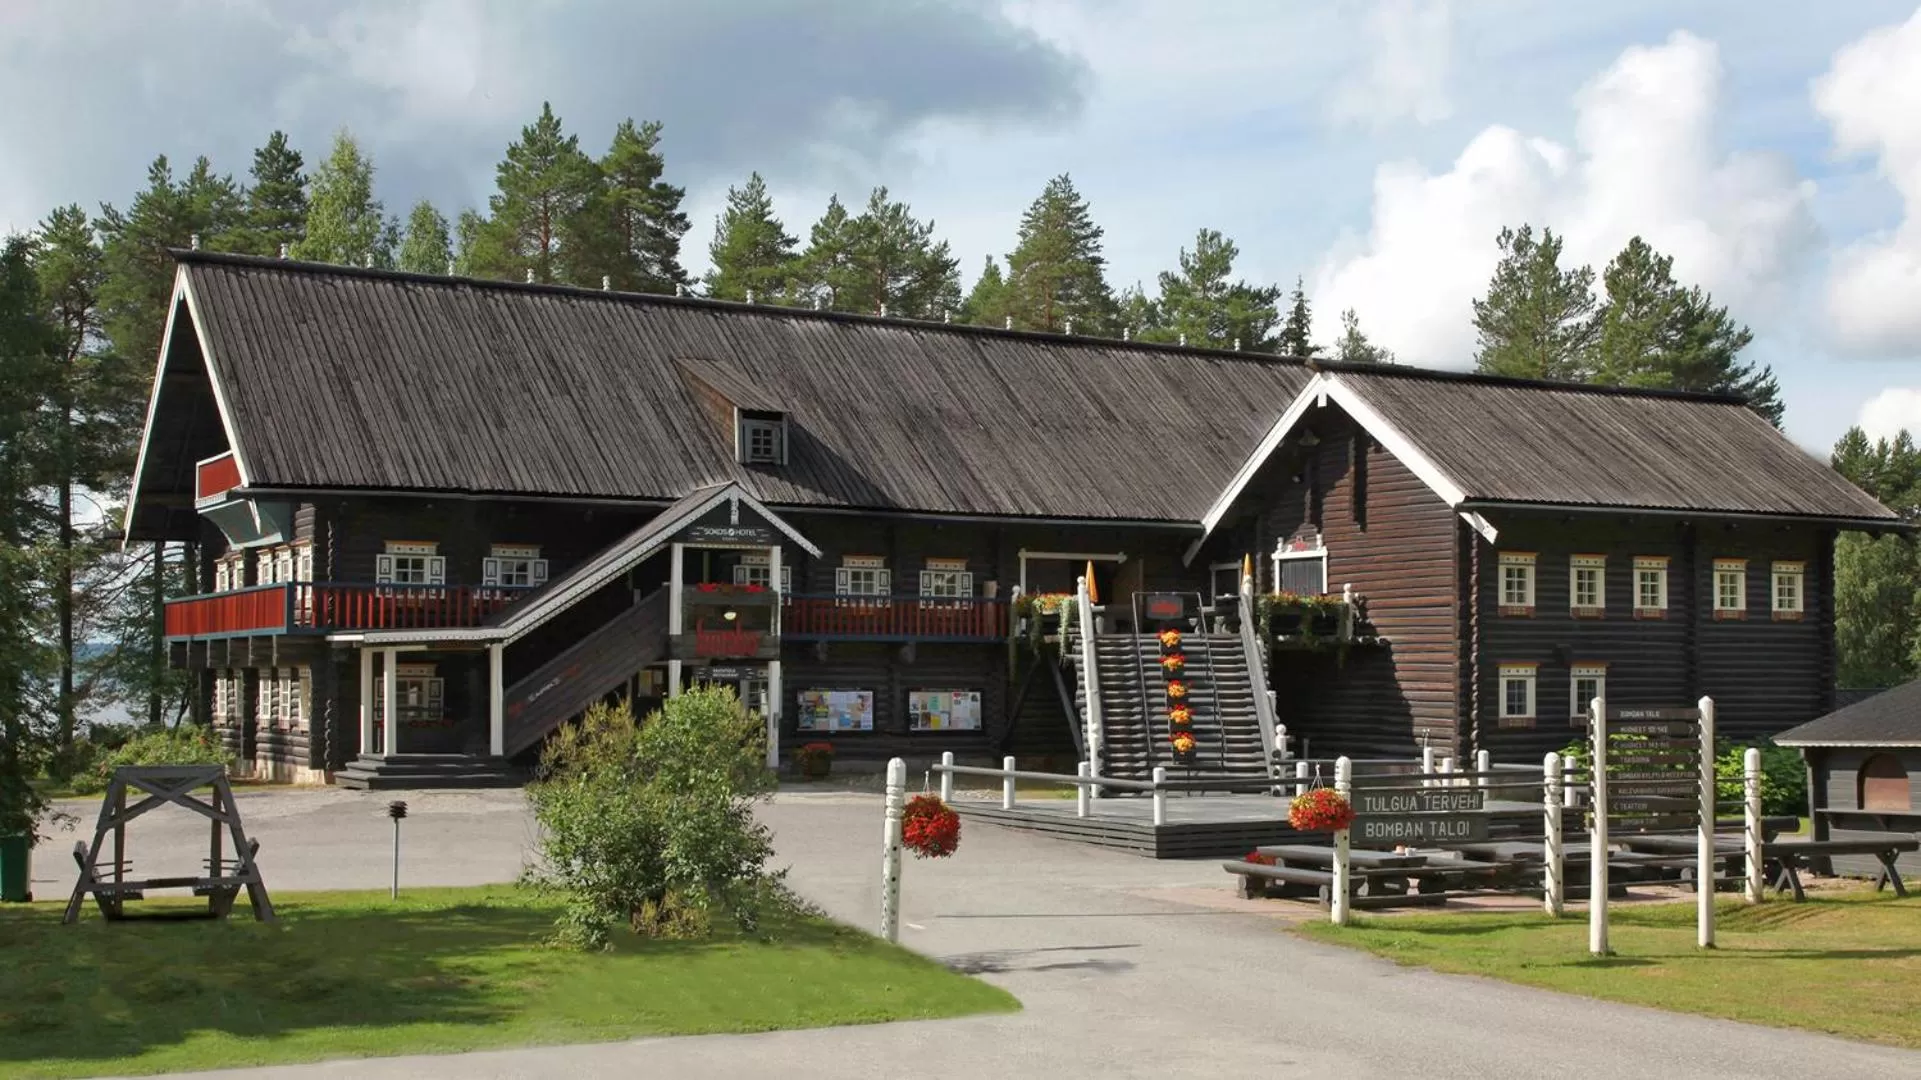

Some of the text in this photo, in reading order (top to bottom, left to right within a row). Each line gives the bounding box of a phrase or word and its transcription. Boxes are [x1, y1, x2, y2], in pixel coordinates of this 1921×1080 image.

[1364, 796, 1417, 812] TULGUA
[1365, 820, 1470, 837] BOMBAN TALOI
